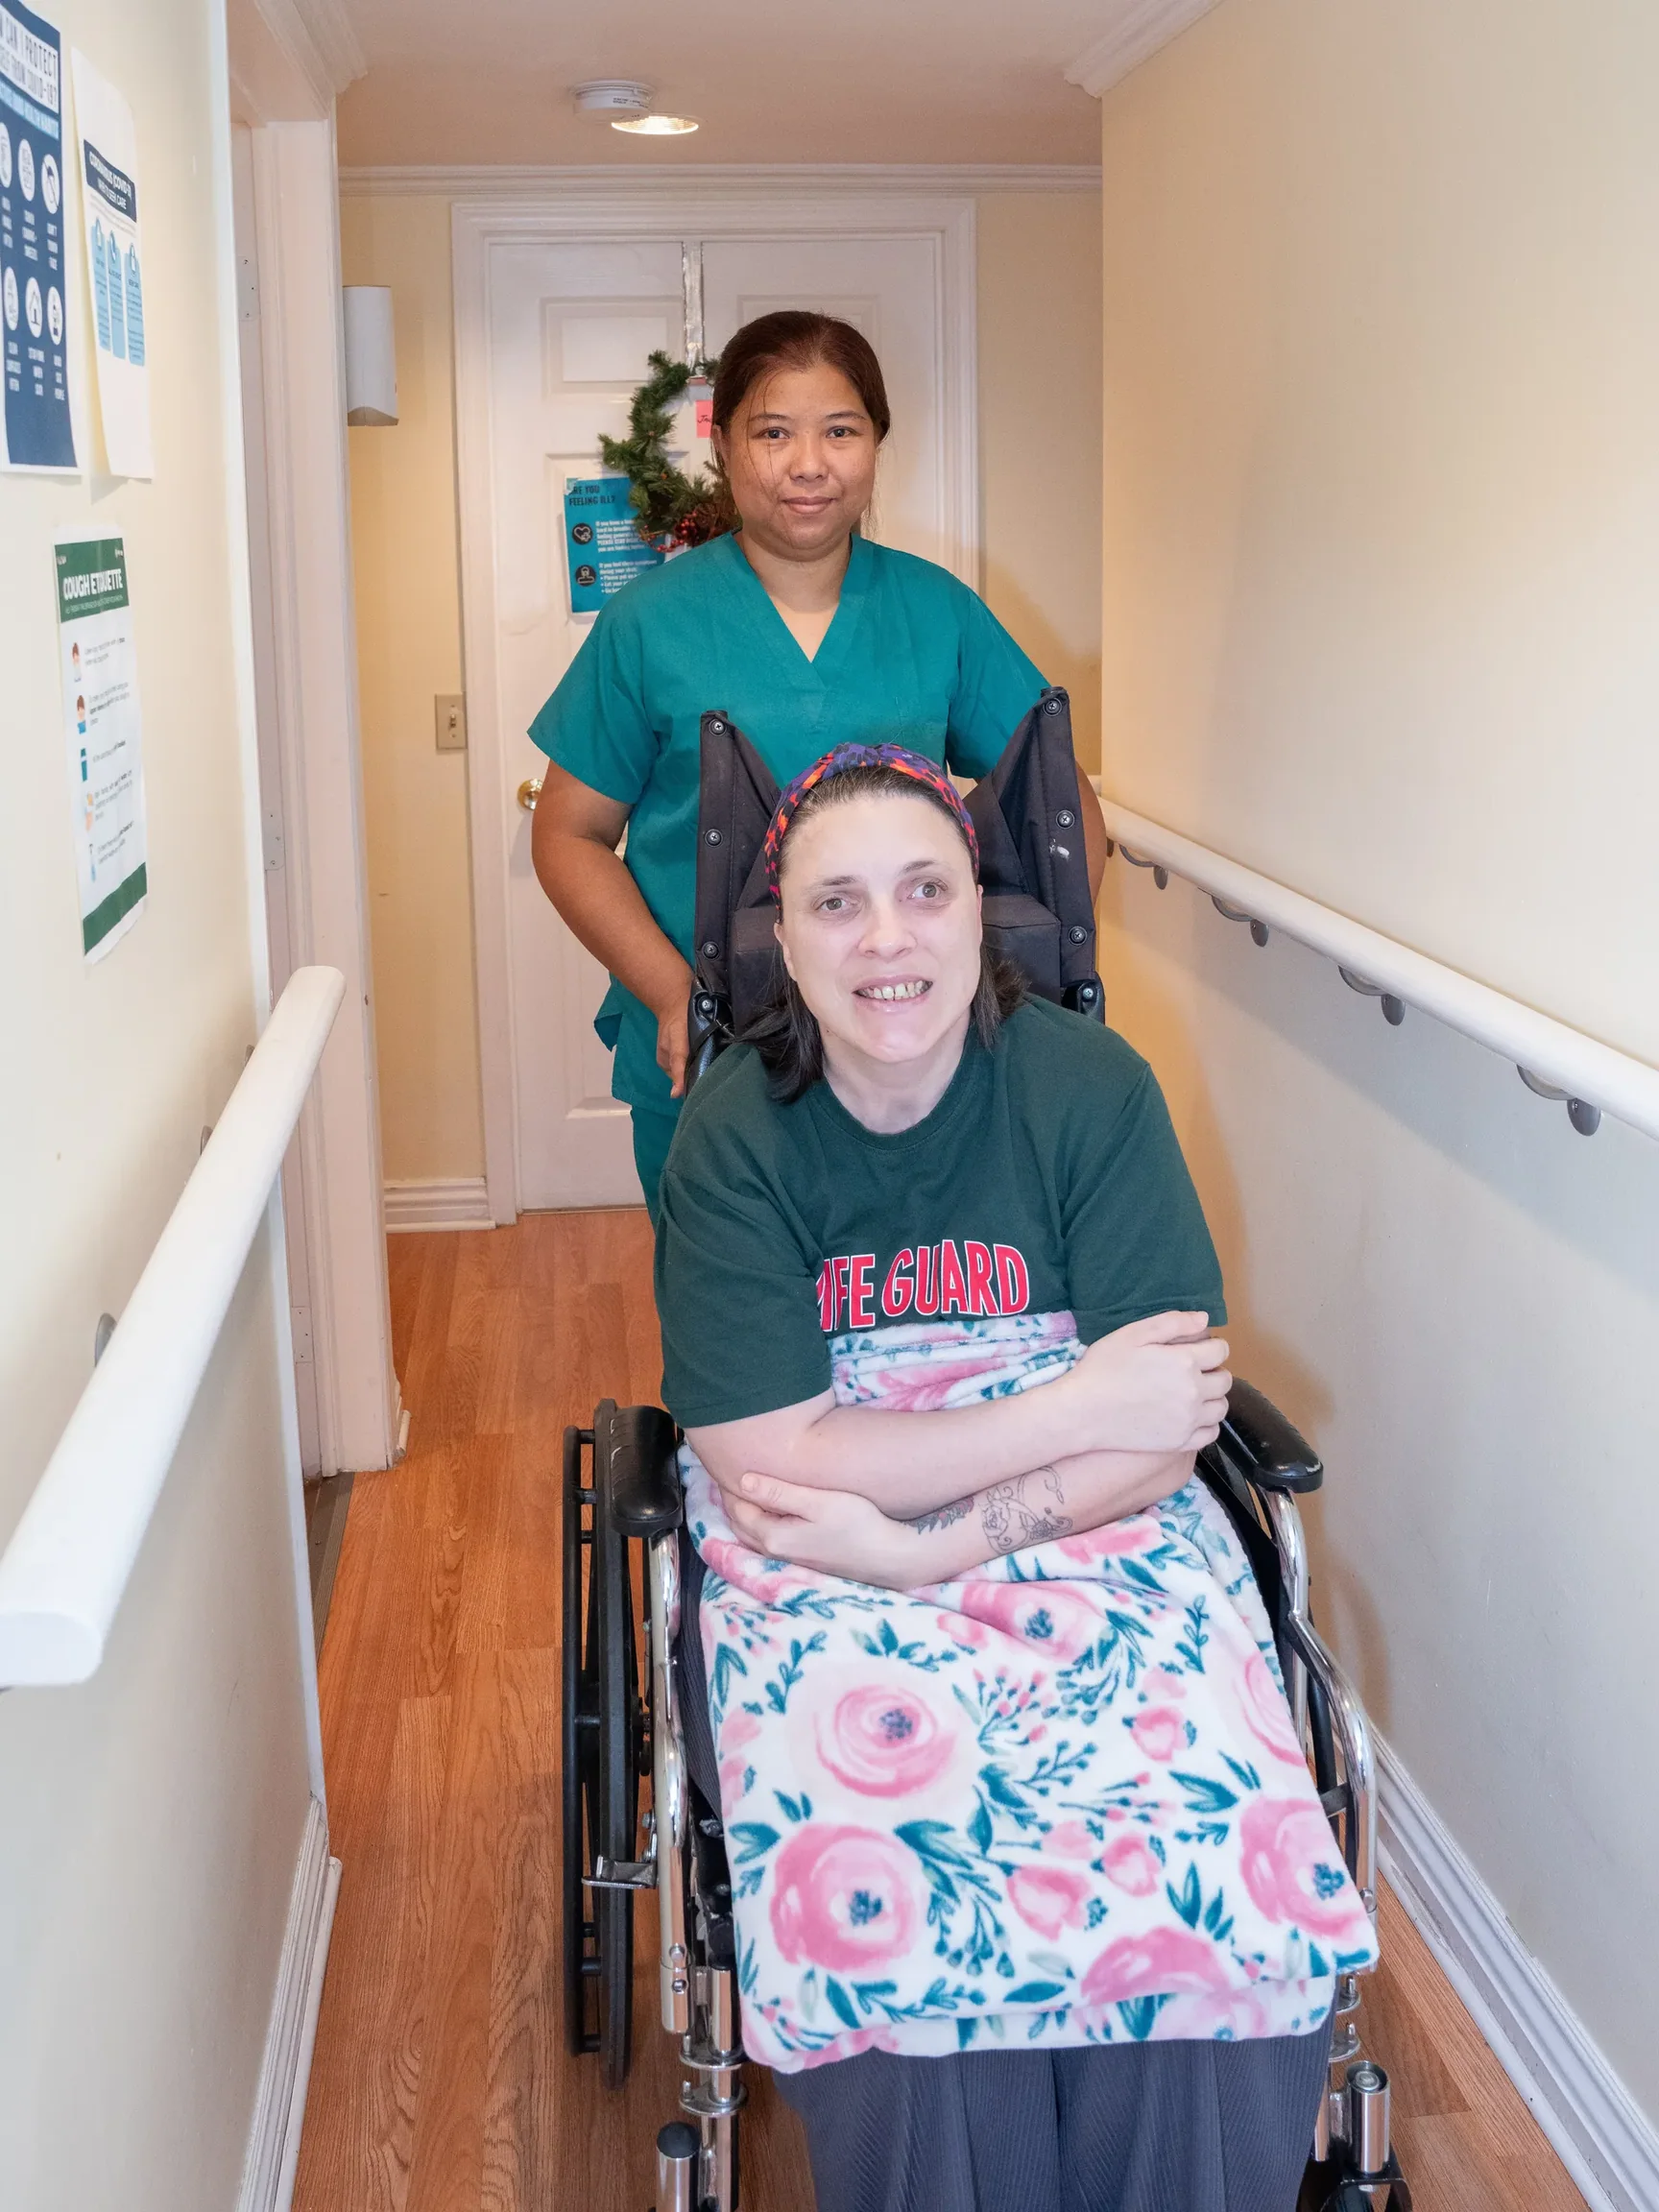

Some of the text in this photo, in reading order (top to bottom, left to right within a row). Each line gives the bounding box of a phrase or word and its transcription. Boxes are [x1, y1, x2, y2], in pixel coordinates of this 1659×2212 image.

[25, 35, 56, 79] PROTECT
[569, 495, 615, 506] FEELING ILL?
[586, 485, 600, 494] YOU
[63, 568, 123, 601] COUGH ETIQUETTE
[881, 1239, 1030, 1316] GUARD
